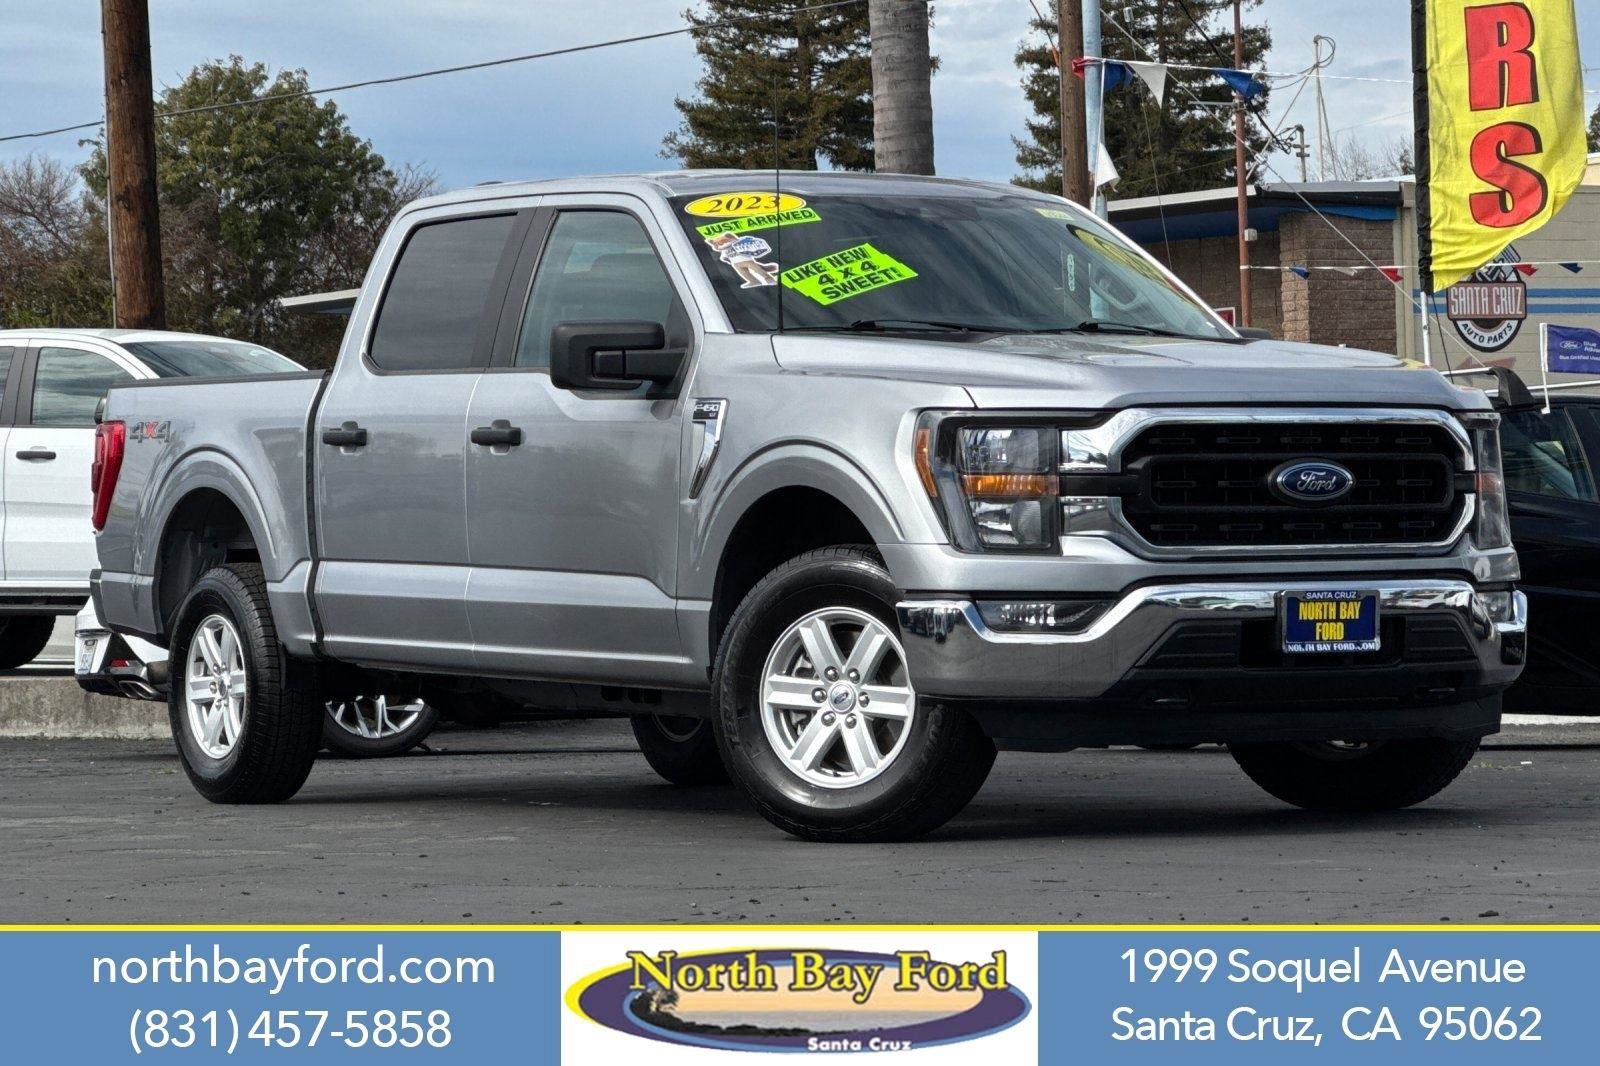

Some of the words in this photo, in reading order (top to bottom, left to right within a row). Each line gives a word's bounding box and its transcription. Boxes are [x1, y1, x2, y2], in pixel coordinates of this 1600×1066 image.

[705, 195, 780, 213] 2023
[704, 222, 740, 236] JUST
[747, 208, 814, 227] ARRIVED
[783, 262, 827, 285] LIKE
[827, 246, 872, 268] NEW
[817, 272, 838, 286] 4
[859, 259, 881, 273] 4
[820, 267, 903, 299] SWEET!
[1450, 286, 1489, 315] SANTA
[1492, 286, 1523, 315] CRUZ
[1461, 322, 1486, 343] AUTO
[1486, 322, 1514, 344] PARTS
[1297, 470, 1337, 491] Ford
[1306, 591, 1333, 600] SANTA
[1334, 591, 1357, 600] CRUZ
[1299, 601, 1337, 621] NORTH
[1340, 601, 1361, 620] BAY
[1315, 621, 1345, 641] FORD
[1316, 643, 1332, 652] BAY
